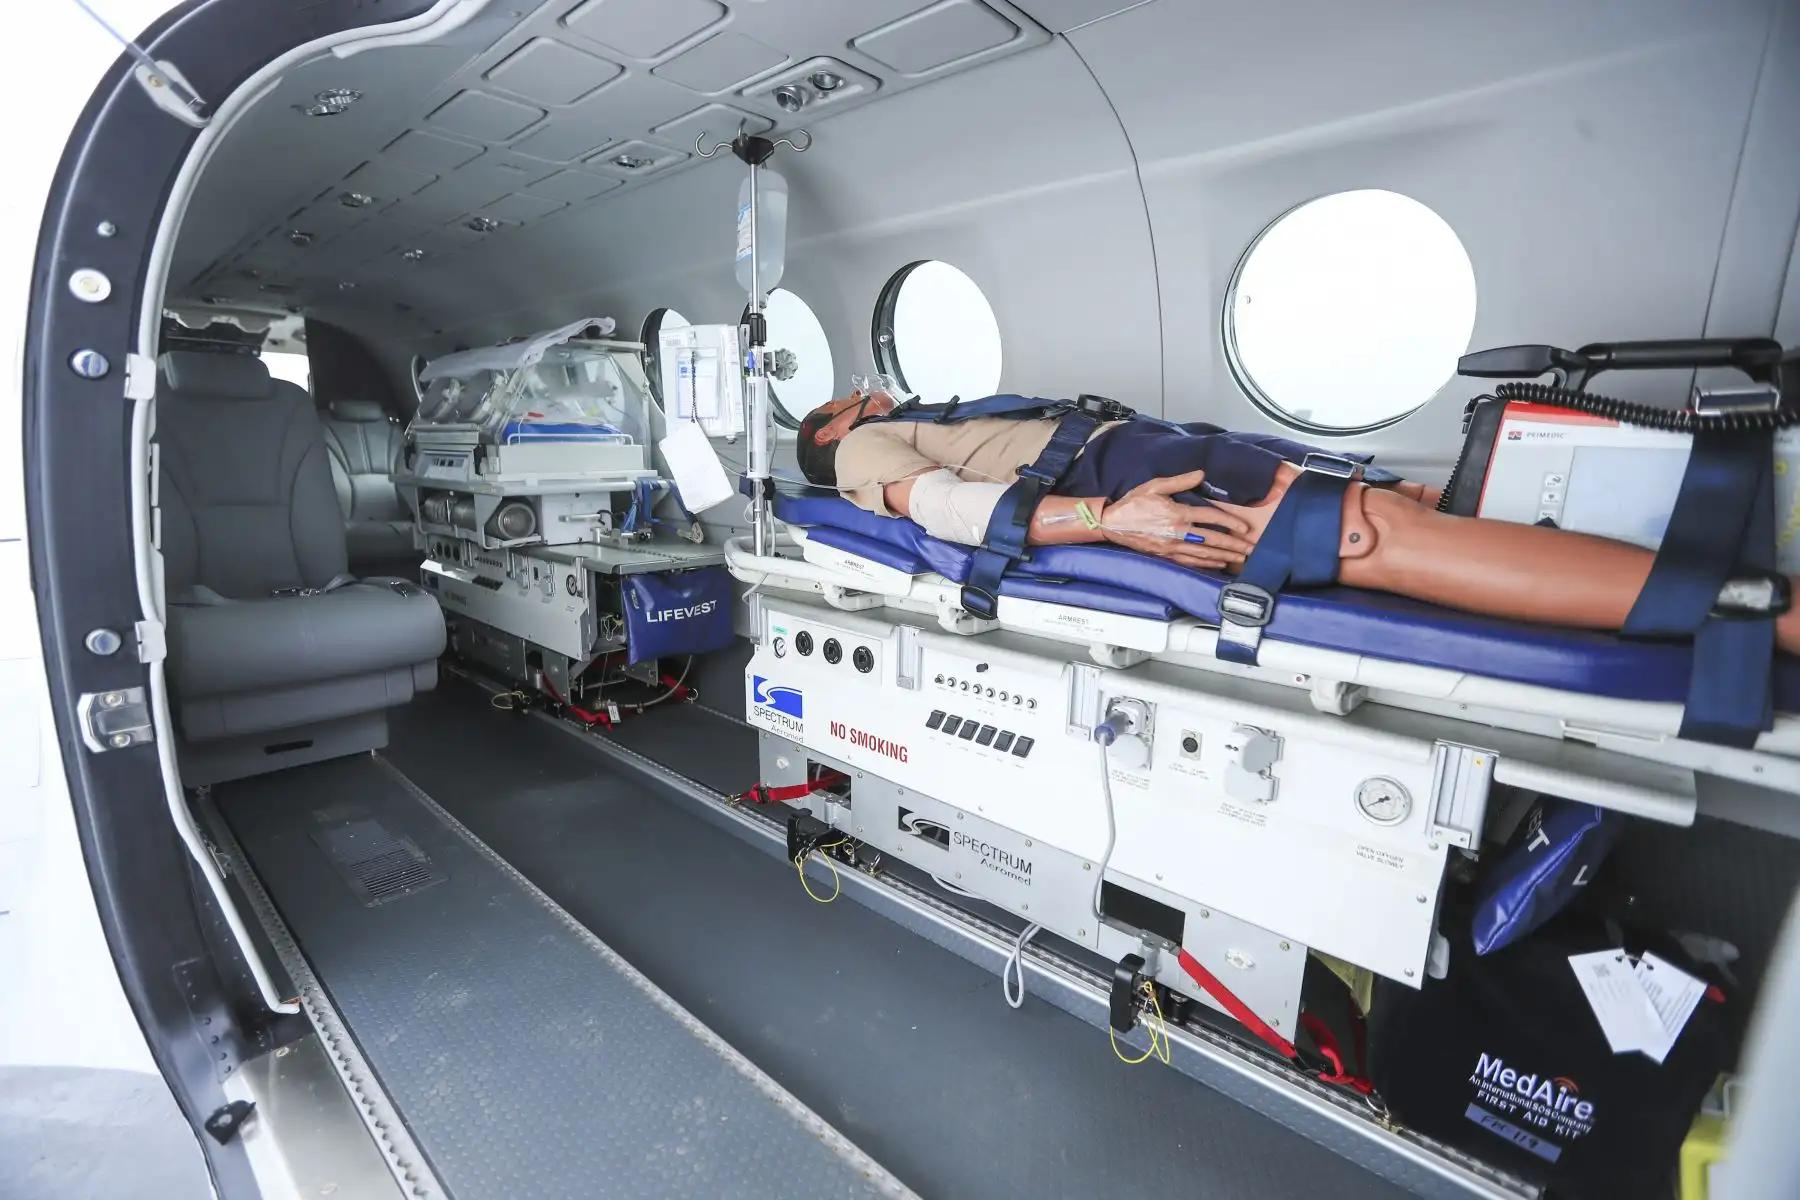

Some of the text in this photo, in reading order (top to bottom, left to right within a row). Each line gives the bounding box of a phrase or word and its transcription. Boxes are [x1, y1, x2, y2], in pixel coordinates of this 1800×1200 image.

[1526, 431, 1565, 439] PRIMEDIC
[646, 600, 717, 623] LIFEVEST
[1058, 614, 1089, 625] ARMREST
[753, 705, 804, 734] SPECTRUM
[770, 724, 804, 744] Aeromed
[830, 720, 846, 740] NO
[850, 728, 908, 764] SMOKING
[953, 831, 1032, 876] SPECTRUM
[981, 858, 1031, 886] Aeromed
[1469, 1074, 1481, 1087] An
[1474, 1052, 1594, 1120] MedAire
[1477, 1090, 1581, 1140] FIRST AID KIT
